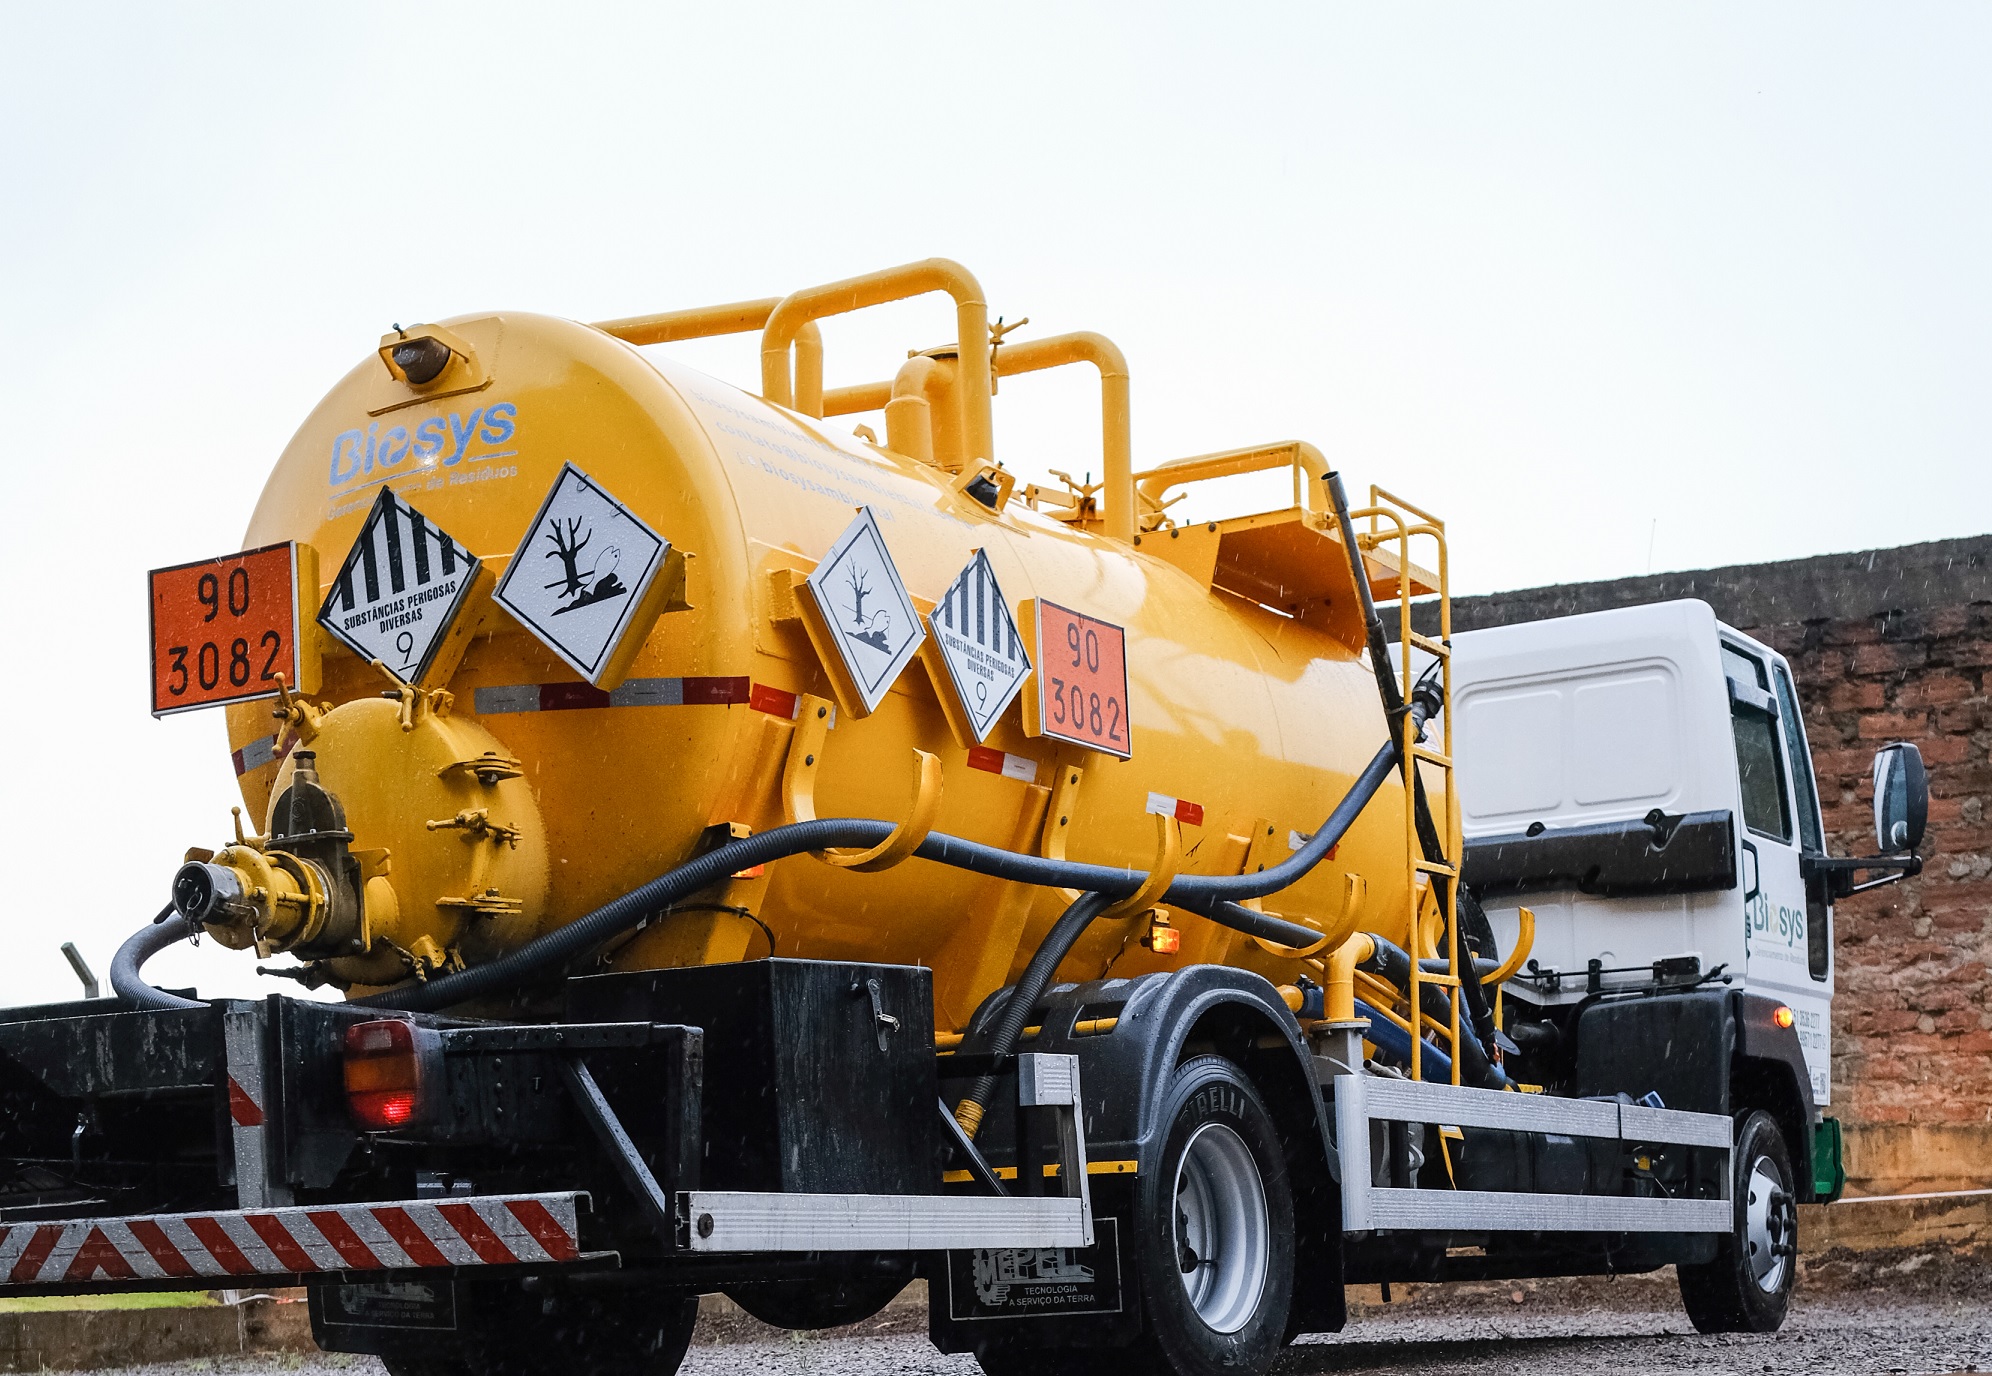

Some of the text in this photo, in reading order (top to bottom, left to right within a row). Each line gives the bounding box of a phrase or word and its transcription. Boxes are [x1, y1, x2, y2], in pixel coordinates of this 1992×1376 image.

[328, 402, 517, 487] Biosys
[759, 457, 896, 522] biosysambietal
[198, 567, 249, 623] 90
[344, 580, 456, 630] SUBSTÂNCIAS PERIGOSAS
[380, 608, 423, 634] DIVERSAS
[168, 630, 281, 696] 3082
[396, 631, 414, 665] 9
[945, 633, 1015, 679] SUBSTÂNCIAS PERIGOSAS
[967, 658, 994, 682] DIVERSAS
[1067, 622, 1099, 673] 90
[976, 681, 987, 711] 9
[1052, 677, 1121, 742] 3082
[1753, 892, 1803, 948] Biosys
[1008, 1294, 1095, 1307] A SERVIÇO DA TERRA
[1024, 1284, 1078, 1295] TECNOLOGIA
